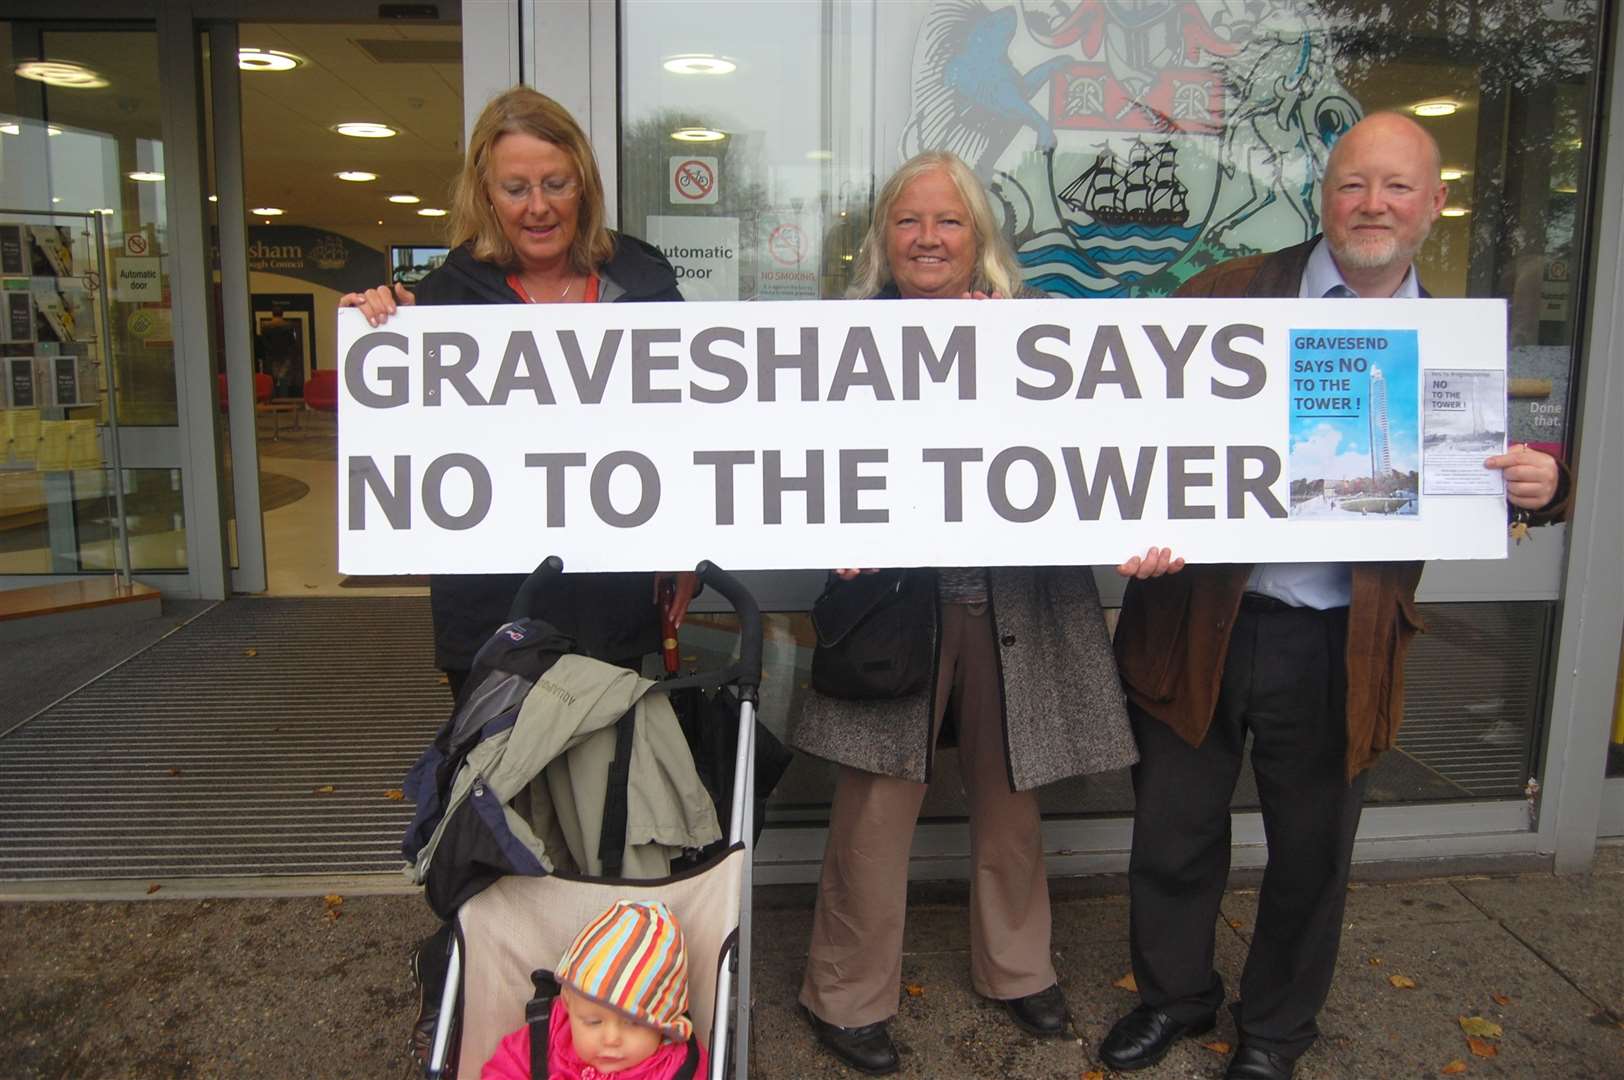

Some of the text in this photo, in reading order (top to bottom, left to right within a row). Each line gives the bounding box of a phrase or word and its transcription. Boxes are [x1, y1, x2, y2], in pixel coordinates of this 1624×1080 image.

[120, 269, 156, 279] Automatic
[674, 265, 713, 279] Door
[761, 271, 773, 281] NO
[130, 281, 148, 290] door
[1294, 337, 1388, 350] GRAVESEND
[345, 324, 1267, 408] GRAVESHAM SAYS
[1294, 358, 1367, 373] SAYS NO
[1294, 379, 1351, 391] TO THE
[1433, 380, 1448, 389] NO
[1432, 391, 1461, 399] TO THE
[1294, 397, 1352, 410] TOWER
[1530, 402, 1561, 414] Done
[1534, 415, 1561, 427] that.
[348, 445, 1289, 531] NO TO THE TOWER
